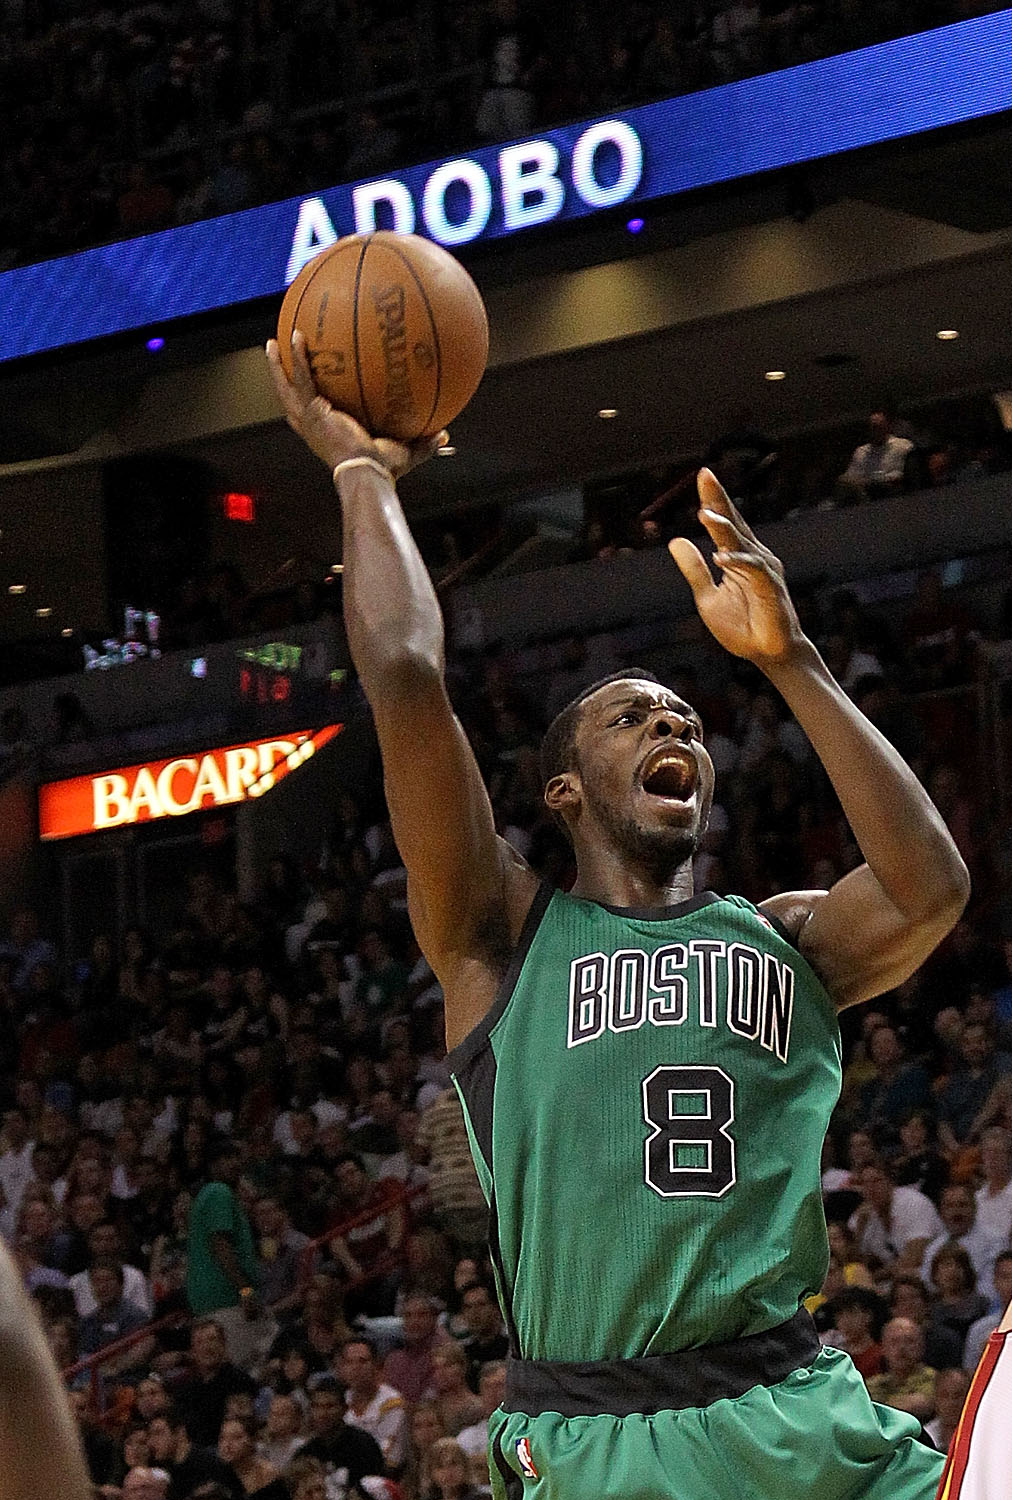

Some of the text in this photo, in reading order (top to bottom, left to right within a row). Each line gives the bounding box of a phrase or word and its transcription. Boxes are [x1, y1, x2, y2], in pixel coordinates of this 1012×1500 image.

[284, 118, 644, 286] ADOBO
[567, 939, 795, 1064] BOSTON
[641, 1065, 737, 1197] 8
